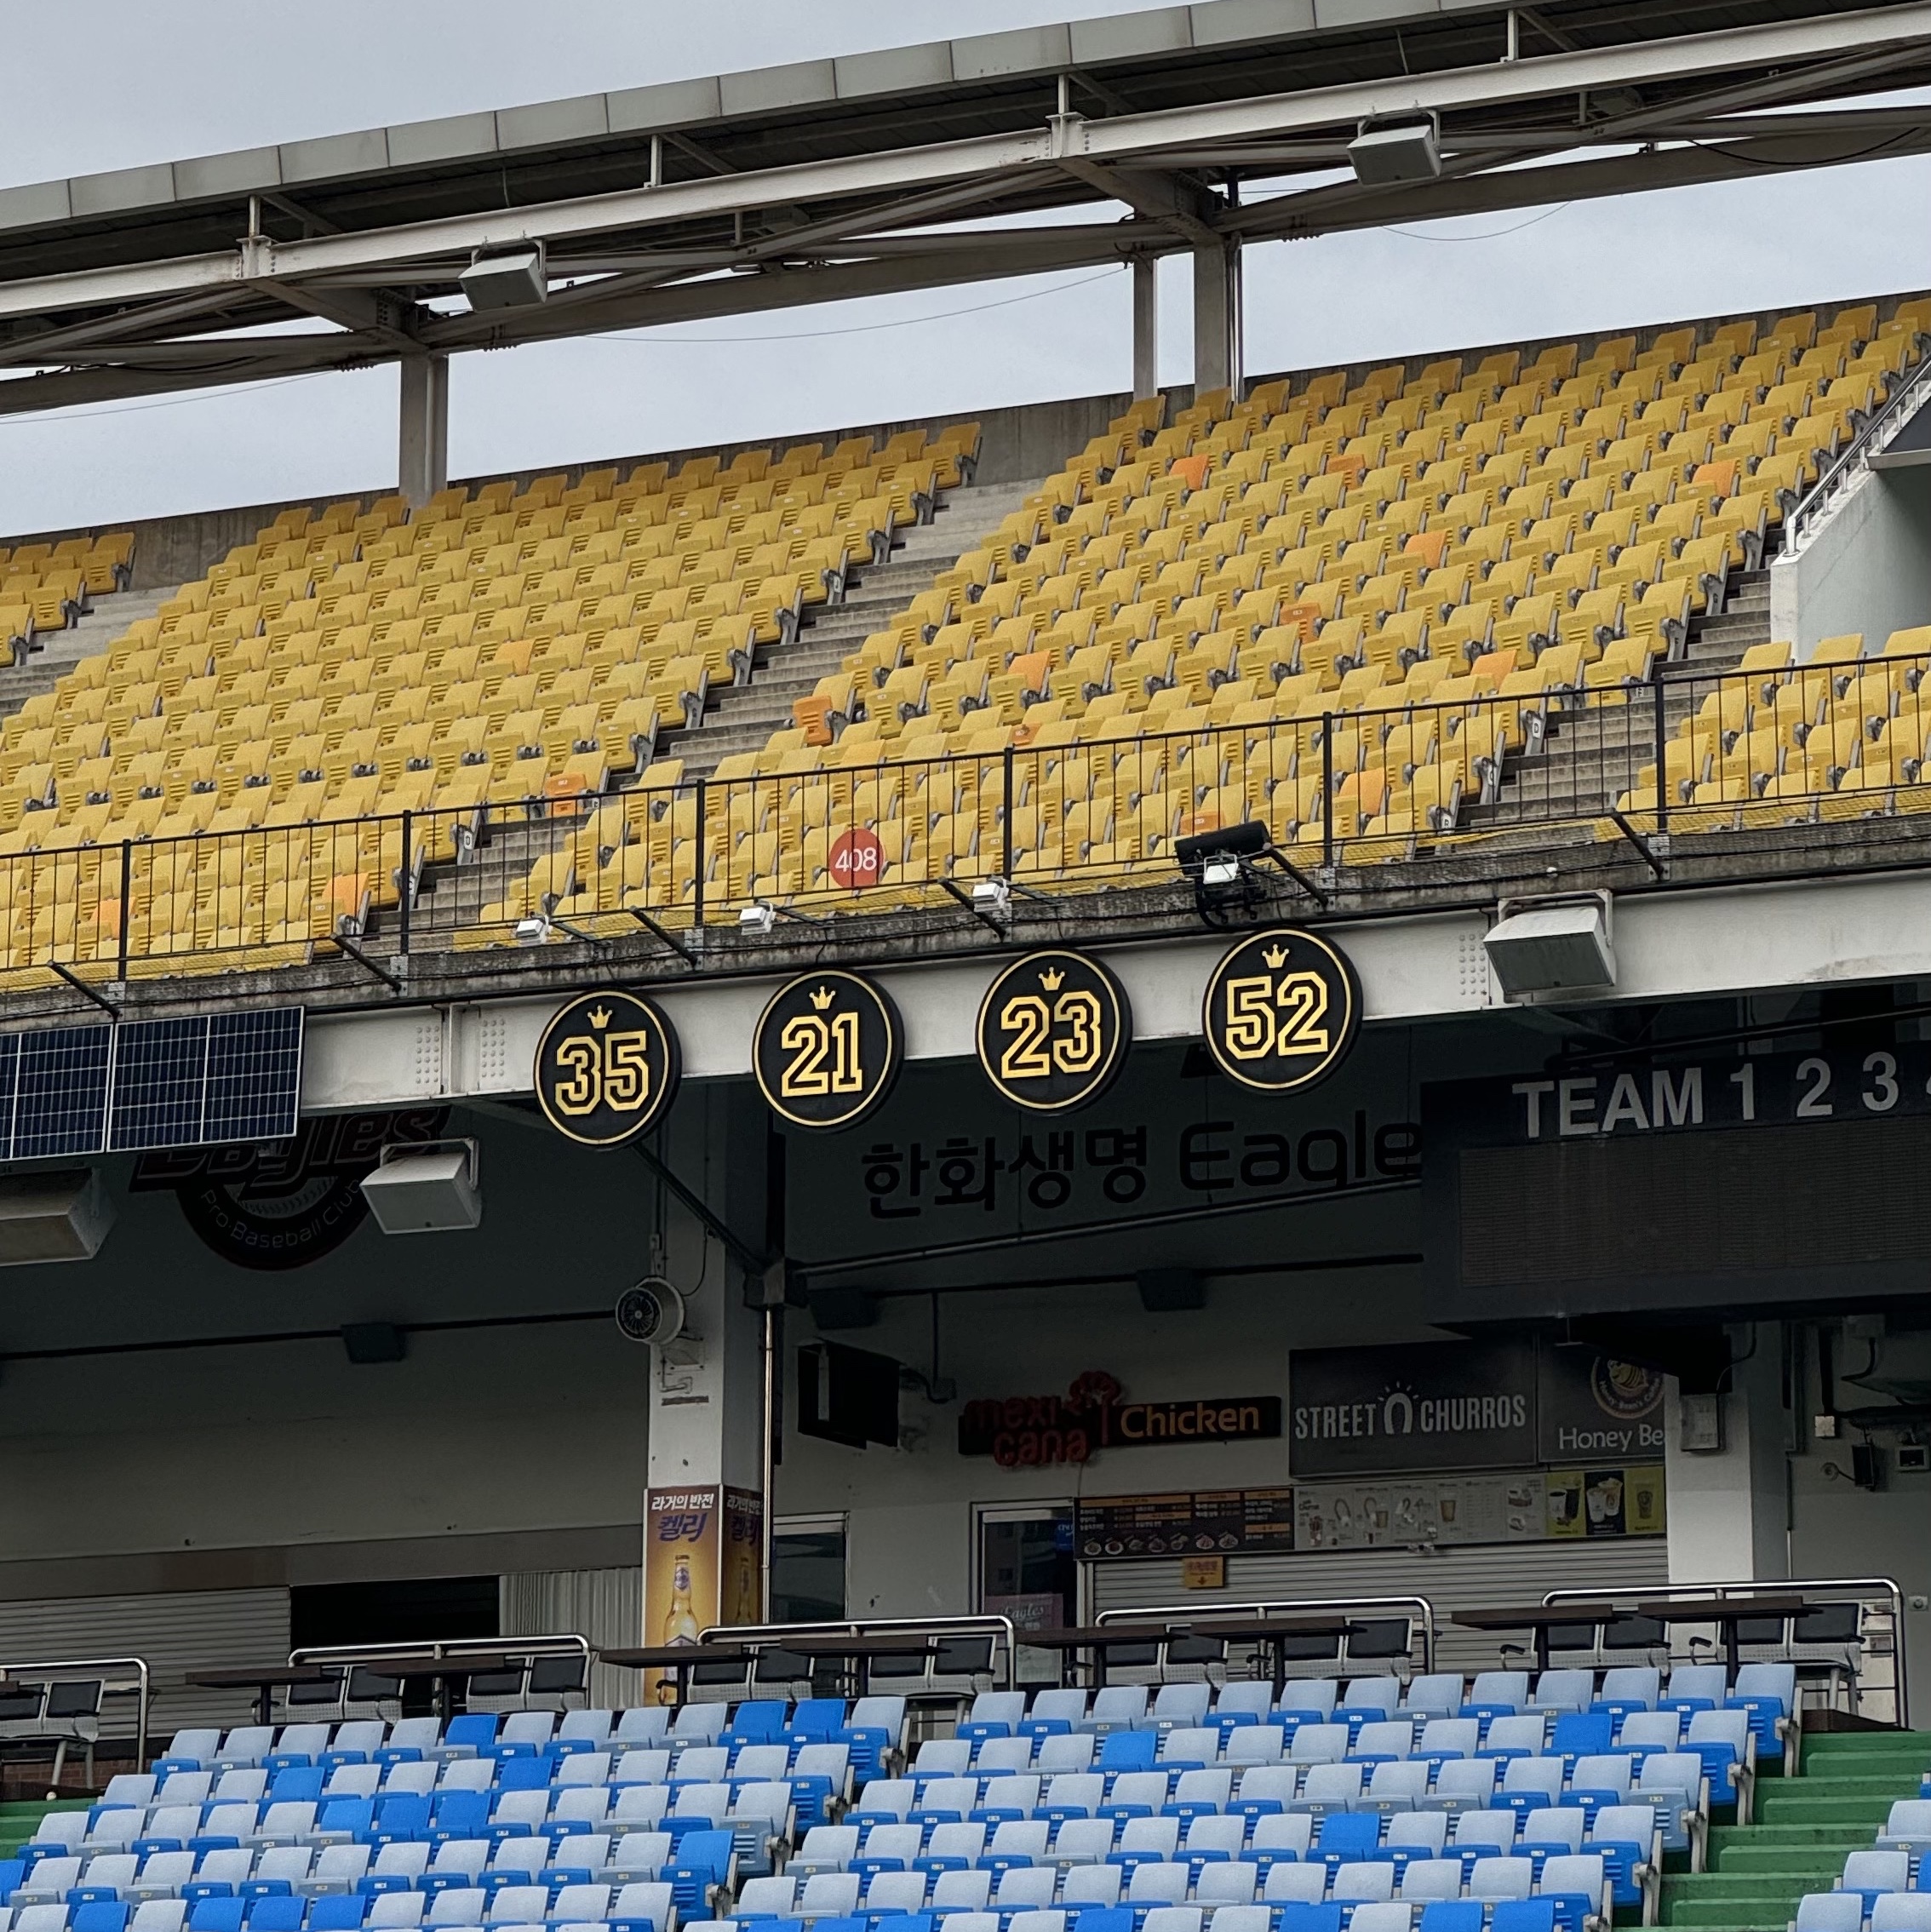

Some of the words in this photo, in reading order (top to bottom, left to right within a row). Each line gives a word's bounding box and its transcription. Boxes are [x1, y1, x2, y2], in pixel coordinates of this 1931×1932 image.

[835, 847, 877, 872] 408
[1000, 990, 1102, 1079] 23
[1225, 971, 1329, 1060] 52
[554, 1029, 650, 1115] 35
[781, 1012, 863, 1098] 21
[1511, 1066, 1704, 1138] TEAM
[1730, 1063, 1755, 1121] 1
[1795, 1057, 1833, 1117] 2
[1861, 1052, 1899, 1111] 3
[862, 1125, 1147, 1218] 한화생명
[966, 1396, 1060, 1434] mexi
[1120, 1402, 1262, 1438] Chicken
[1295, 1403, 1377, 1439] STREET
[1420, 1394, 1526, 1433] CHURROS
[994, 1428, 1090, 1466] cana
[1559, 1426, 1633, 1452] Honey
[651, 1495, 688, 1511] 라거의
[690, 1493, 715, 1510] 반전
[657, 1512, 708, 1542] 켈리
